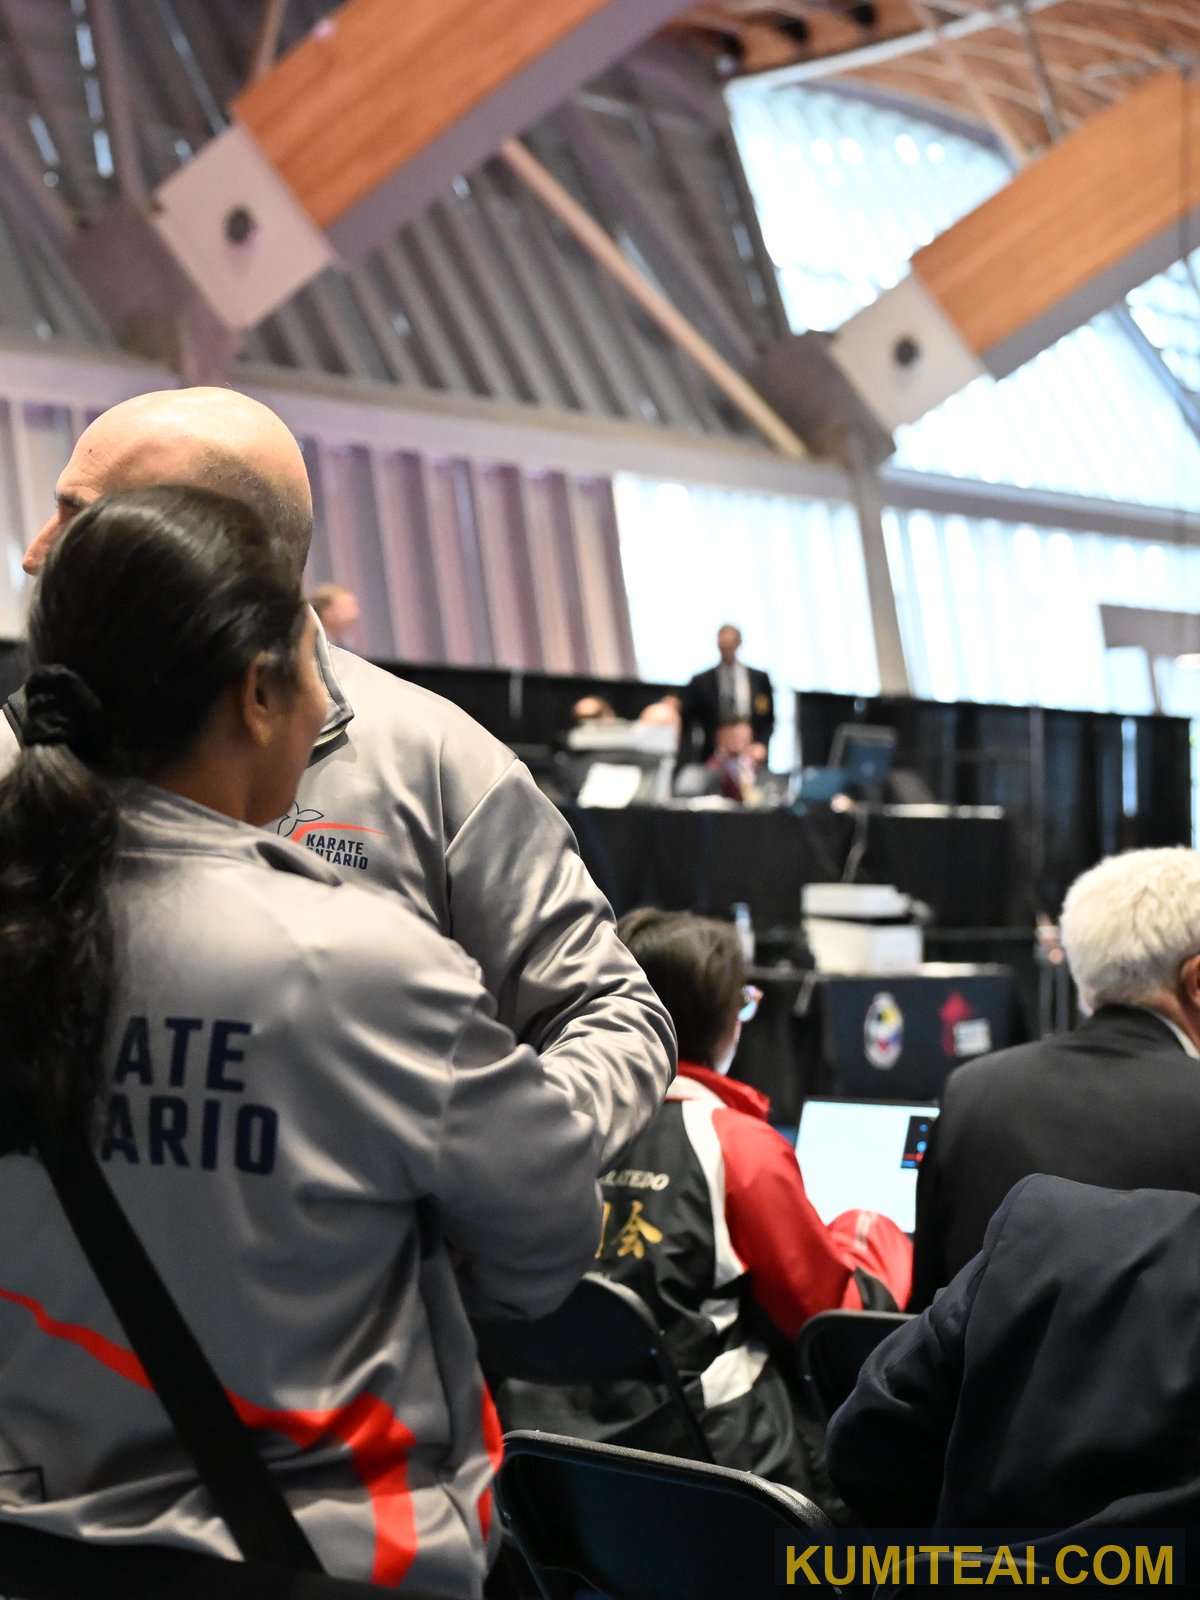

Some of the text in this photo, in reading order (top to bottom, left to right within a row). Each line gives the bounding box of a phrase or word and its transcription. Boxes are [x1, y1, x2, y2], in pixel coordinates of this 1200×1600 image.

[306, 833, 364, 855] KARATE
[307, 846, 369, 870] NTARIO
[113, 1016, 253, 1092] ATE
[101, 1093, 278, 1176] ARIO
